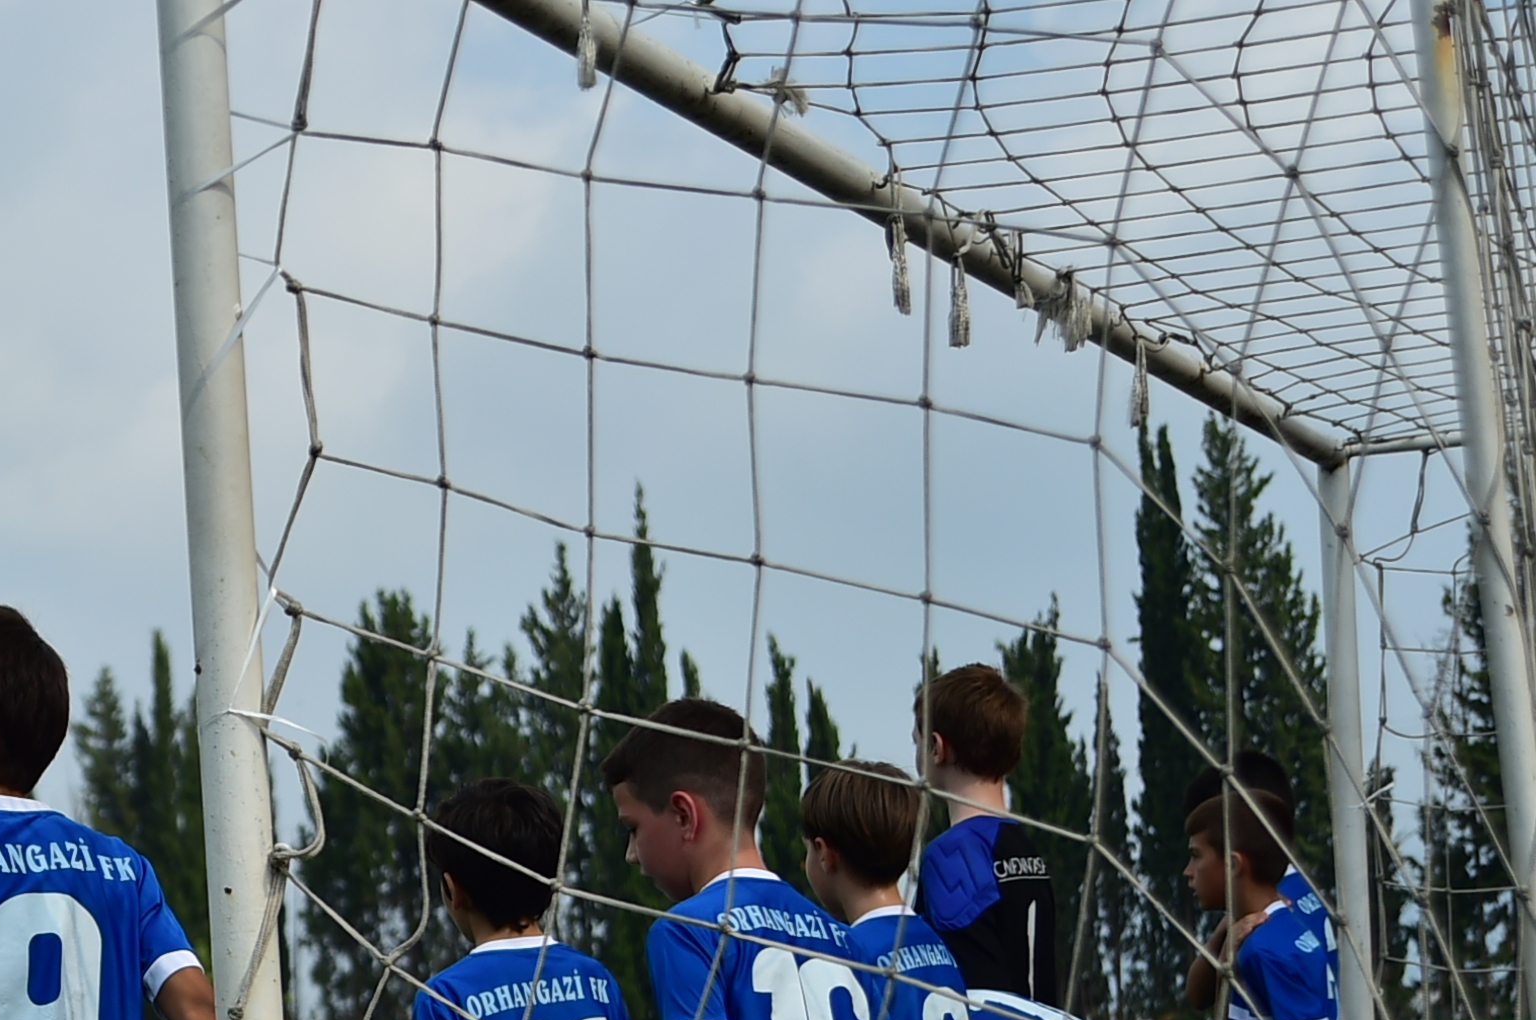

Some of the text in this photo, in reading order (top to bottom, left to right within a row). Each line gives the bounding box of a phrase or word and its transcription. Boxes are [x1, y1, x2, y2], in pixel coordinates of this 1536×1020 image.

[97, 853, 137, 882] FK
[717, 904, 830, 940] ORHANGAZİ
[466, 968, 610, 1020] ORHANGAZİ FK
